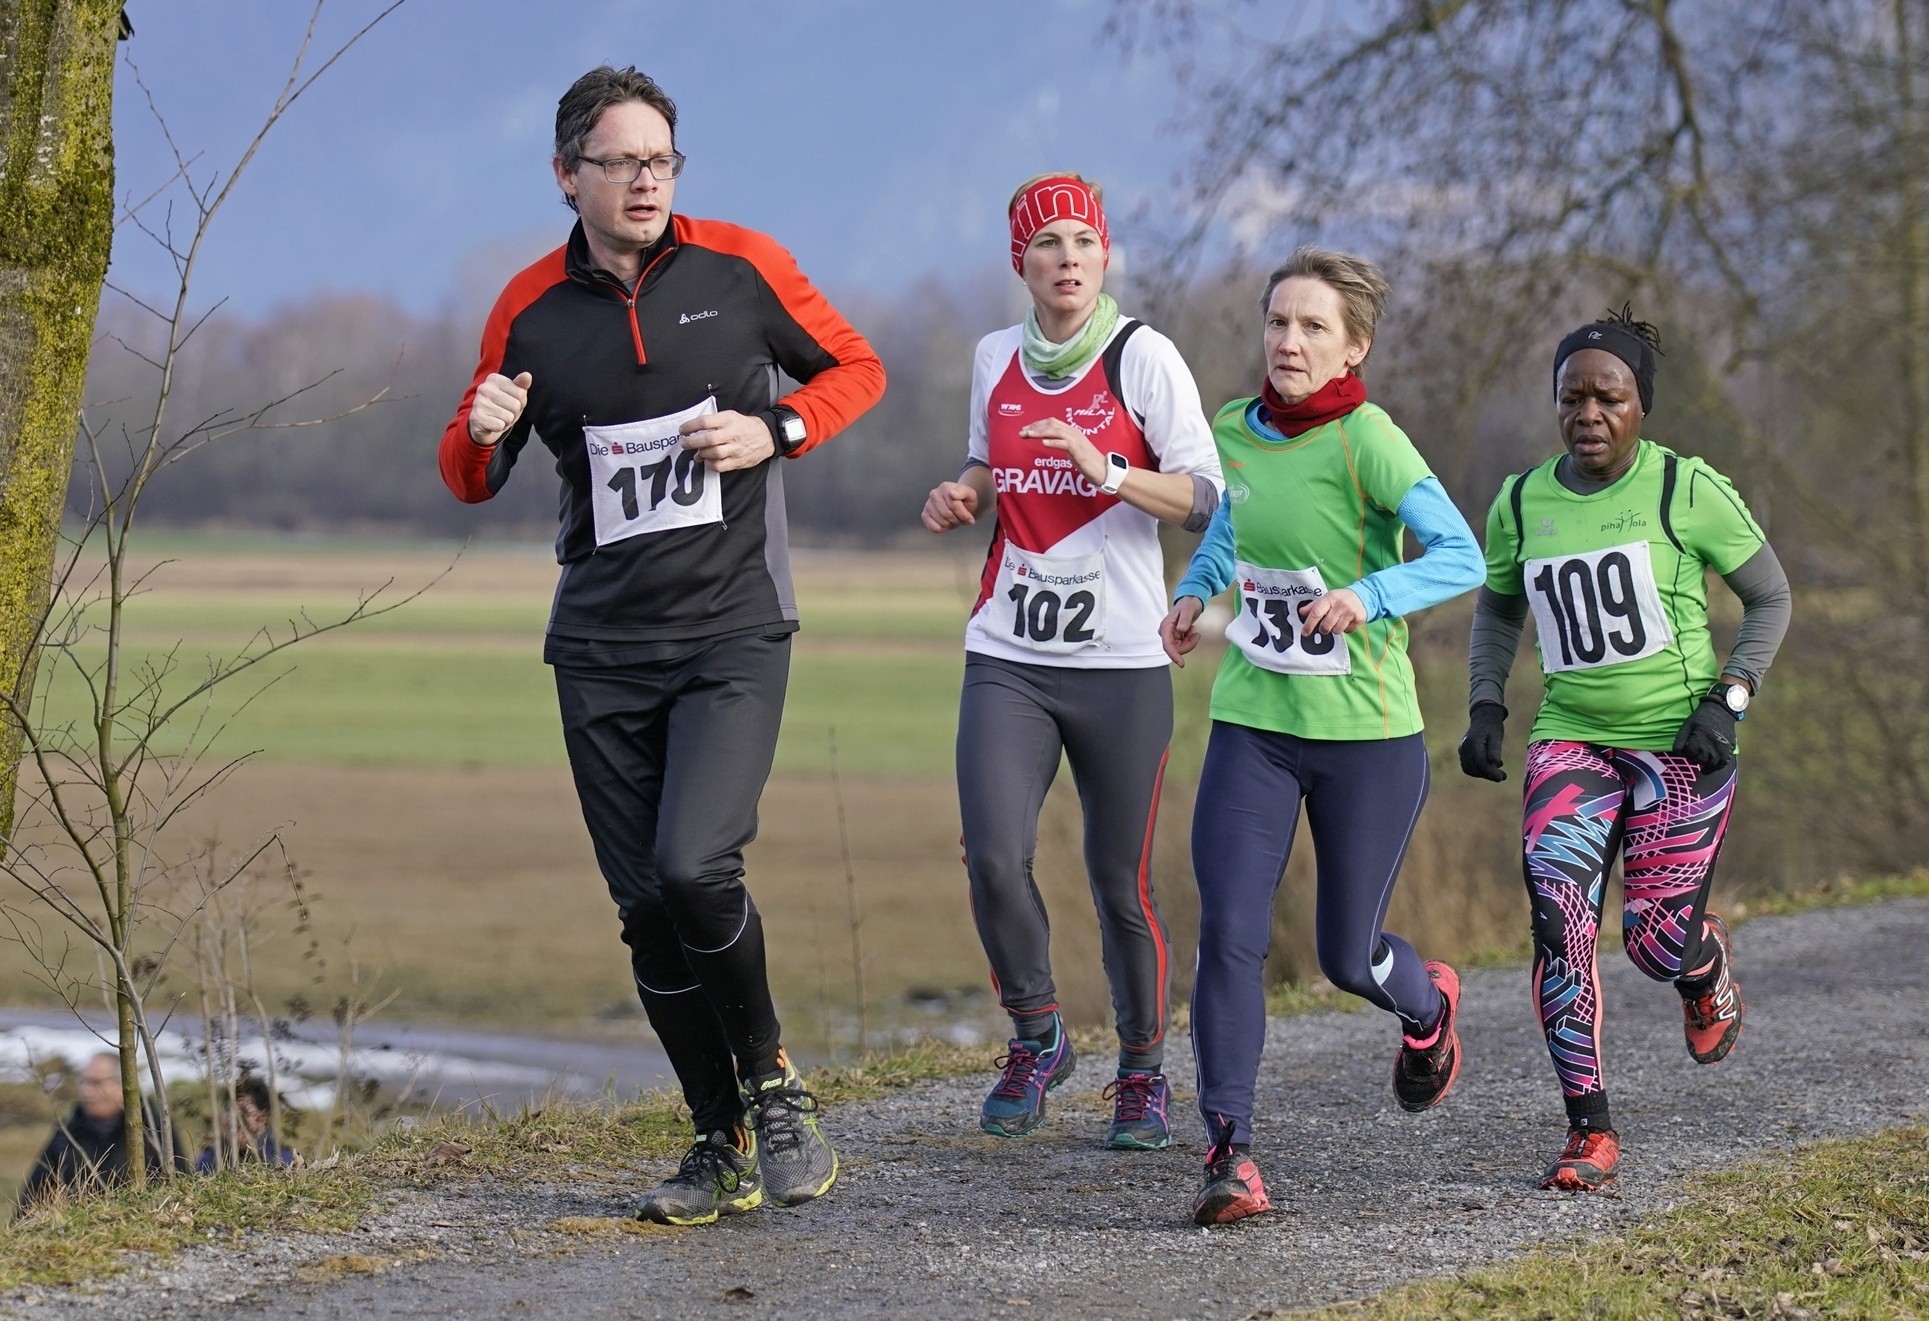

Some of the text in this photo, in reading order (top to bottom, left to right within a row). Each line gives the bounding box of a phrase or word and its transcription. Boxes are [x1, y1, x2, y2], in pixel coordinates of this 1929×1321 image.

[690, 310, 718, 321] odlo
[590, 443, 609, 456] Die
[626, 433, 686, 454] Bauspar
[1034, 456, 1073, 470] erdgas
[607, 449, 705, 521] 170
[992, 467, 1098, 498] GRAVAG
[1028, 568, 1101, 586] Bausparkasse
[1008, 583, 1095, 643] 102
[1533, 551, 1647, 666] 109
